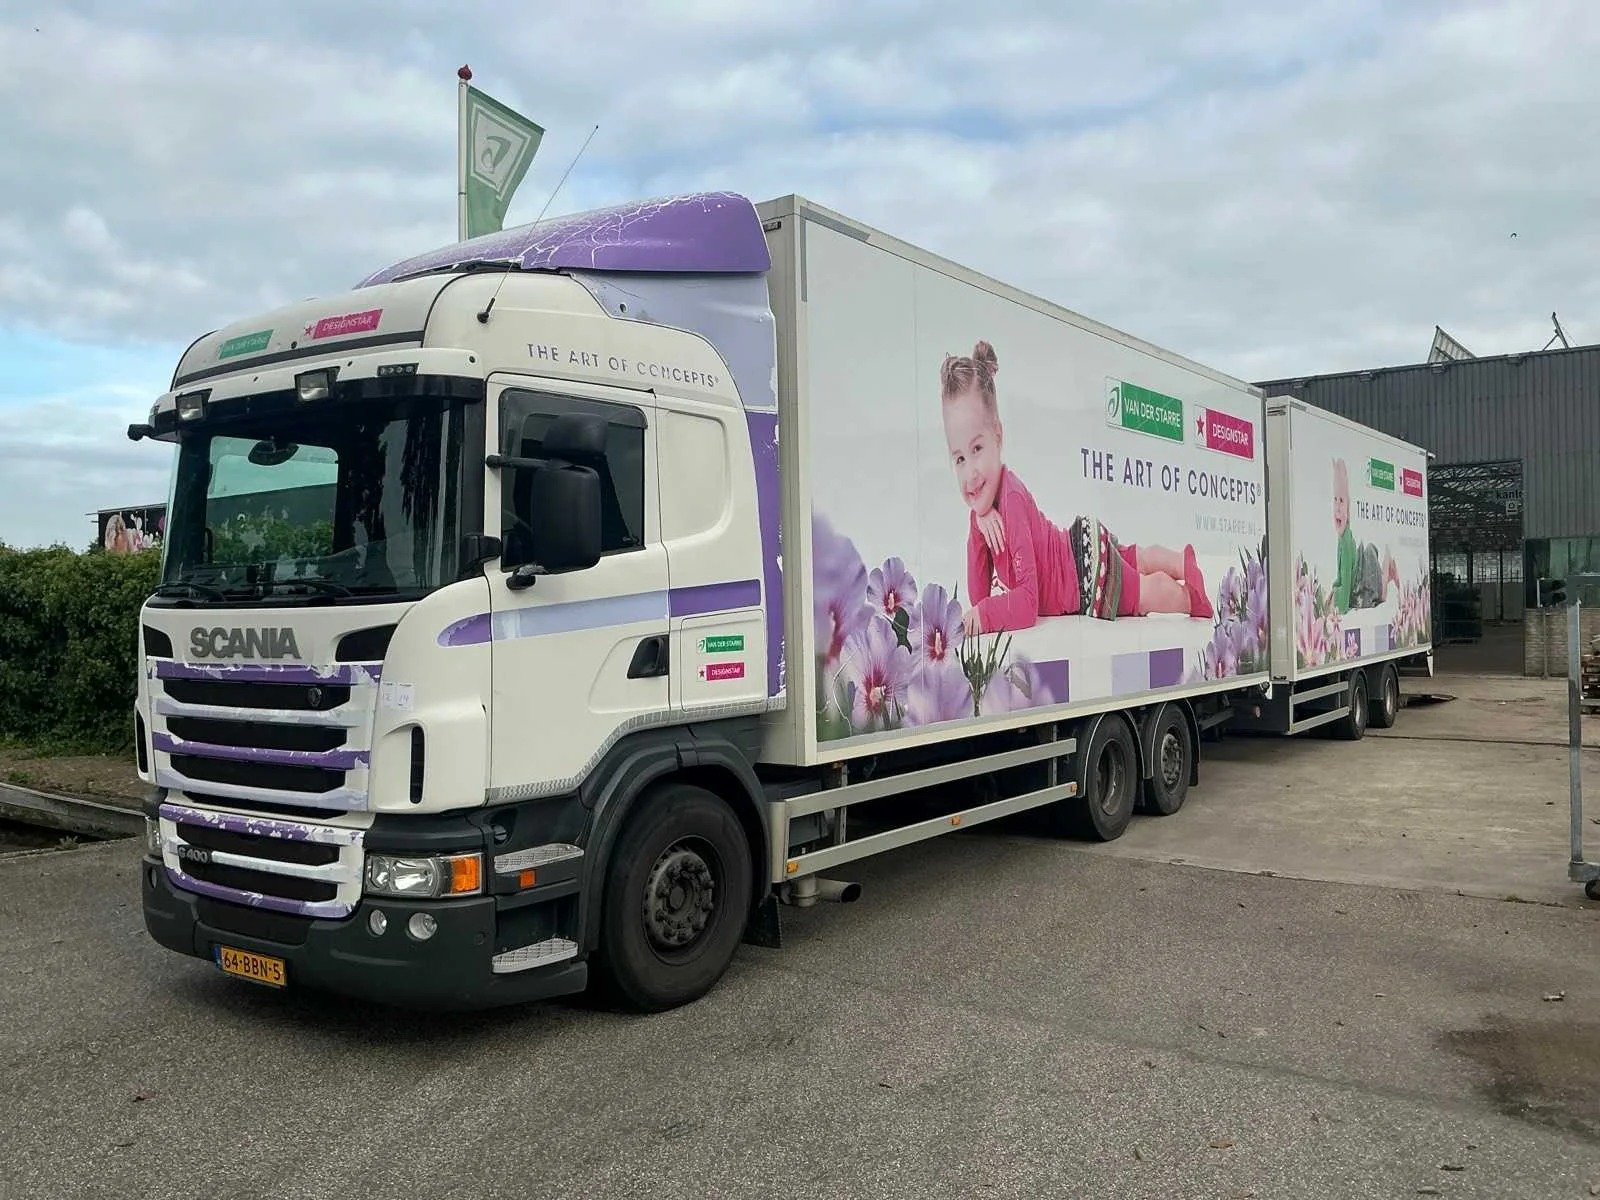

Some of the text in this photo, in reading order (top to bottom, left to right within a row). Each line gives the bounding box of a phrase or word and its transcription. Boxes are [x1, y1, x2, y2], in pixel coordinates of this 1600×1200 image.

[322, 315, 373, 331] DESIGNSTAR
[527, 343, 559, 361] THE
[569, 350, 599, 367] ART
[608, 356, 627, 372] OF
[1124, 397, 1181, 428] VAN DER STARRE
[1212, 423, 1249, 446] DESIGNSTAR
[1081, 448, 1114, 482] THE
[1123, 457, 1153, 488] ART
[1161, 464, 1180, 492] OF
[1357, 501, 1369, 519] THE
[1372, 504, 1383, 520] ART
[1386, 506, 1394, 522] OF
[190, 627, 302, 660] SCANIA
[187, 848, 208, 864] 400
[223, 951, 281, 981] 64-BBN-5
